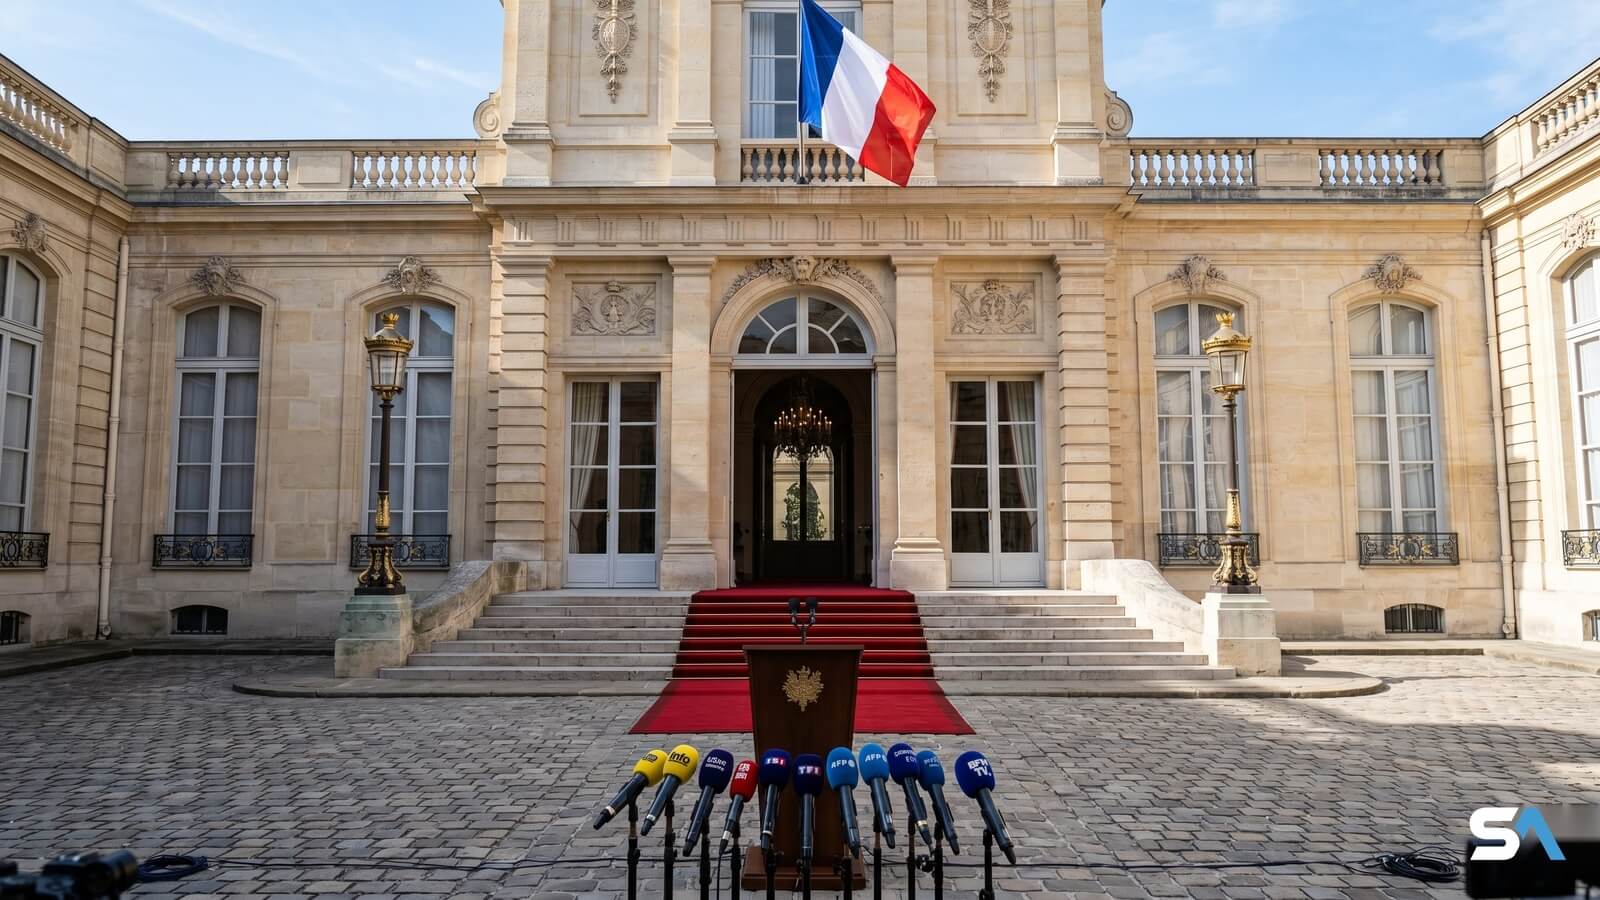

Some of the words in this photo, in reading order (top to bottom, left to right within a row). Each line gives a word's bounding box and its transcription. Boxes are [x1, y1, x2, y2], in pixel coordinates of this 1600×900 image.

[669, 752, 690, 764] info
[865, 753, 881, 762] AFP
[831, 759, 847, 769] AFP
